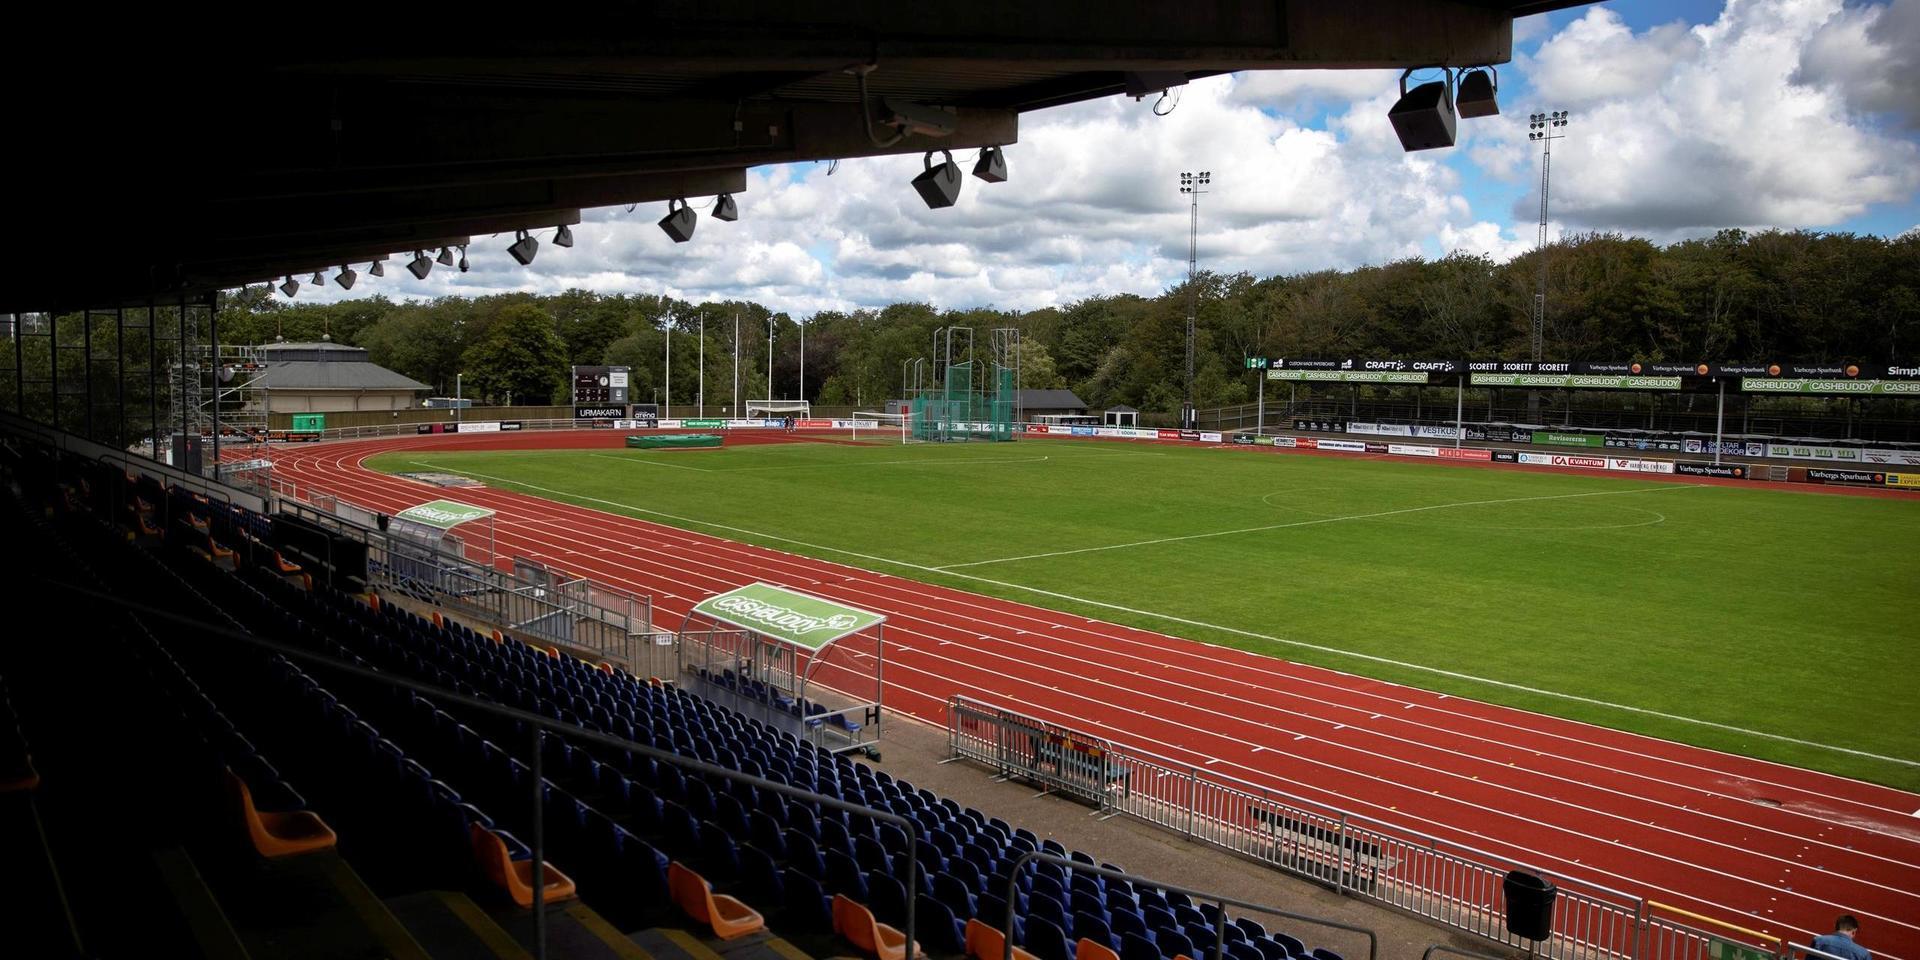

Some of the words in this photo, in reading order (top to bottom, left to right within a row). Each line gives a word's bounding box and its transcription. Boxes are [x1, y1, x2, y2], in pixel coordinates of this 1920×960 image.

[1365, 361, 1397, 369] CRAFT
[1413, 362, 1445, 370] CRAFT
[1469, 363, 1498, 371] SCORETT
[1503, 363, 1533, 371] SCORETT
[1538, 363, 1569, 371] SCORETT
[1573, 377, 1620, 386] CASHBUDDY
[1629, 379, 1678, 387] CASHBUDDY
[1744, 381, 1801, 389] CASHBUDDY
[1811, 382, 1873, 390] CASHBUDDY
[1422, 426, 1459, 436] VESTKUS
[1708, 441, 1739, 449] SKLTAR
[1708, 447, 1744, 456] BIDEKOR
[1552, 456, 1567, 465] ICA
[1569, 458, 1604, 467] KVANTUM
[1679, 465, 1704, 474] Varbergs
[1704, 467, 1732, 475] Sparbank
[1810, 470, 1839, 480] Varbergs
[1840, 472, 1871, 481] Sparbank
[716, 597, 823, 633] CASHBUDDY
[865, 706, 879, 726] H
